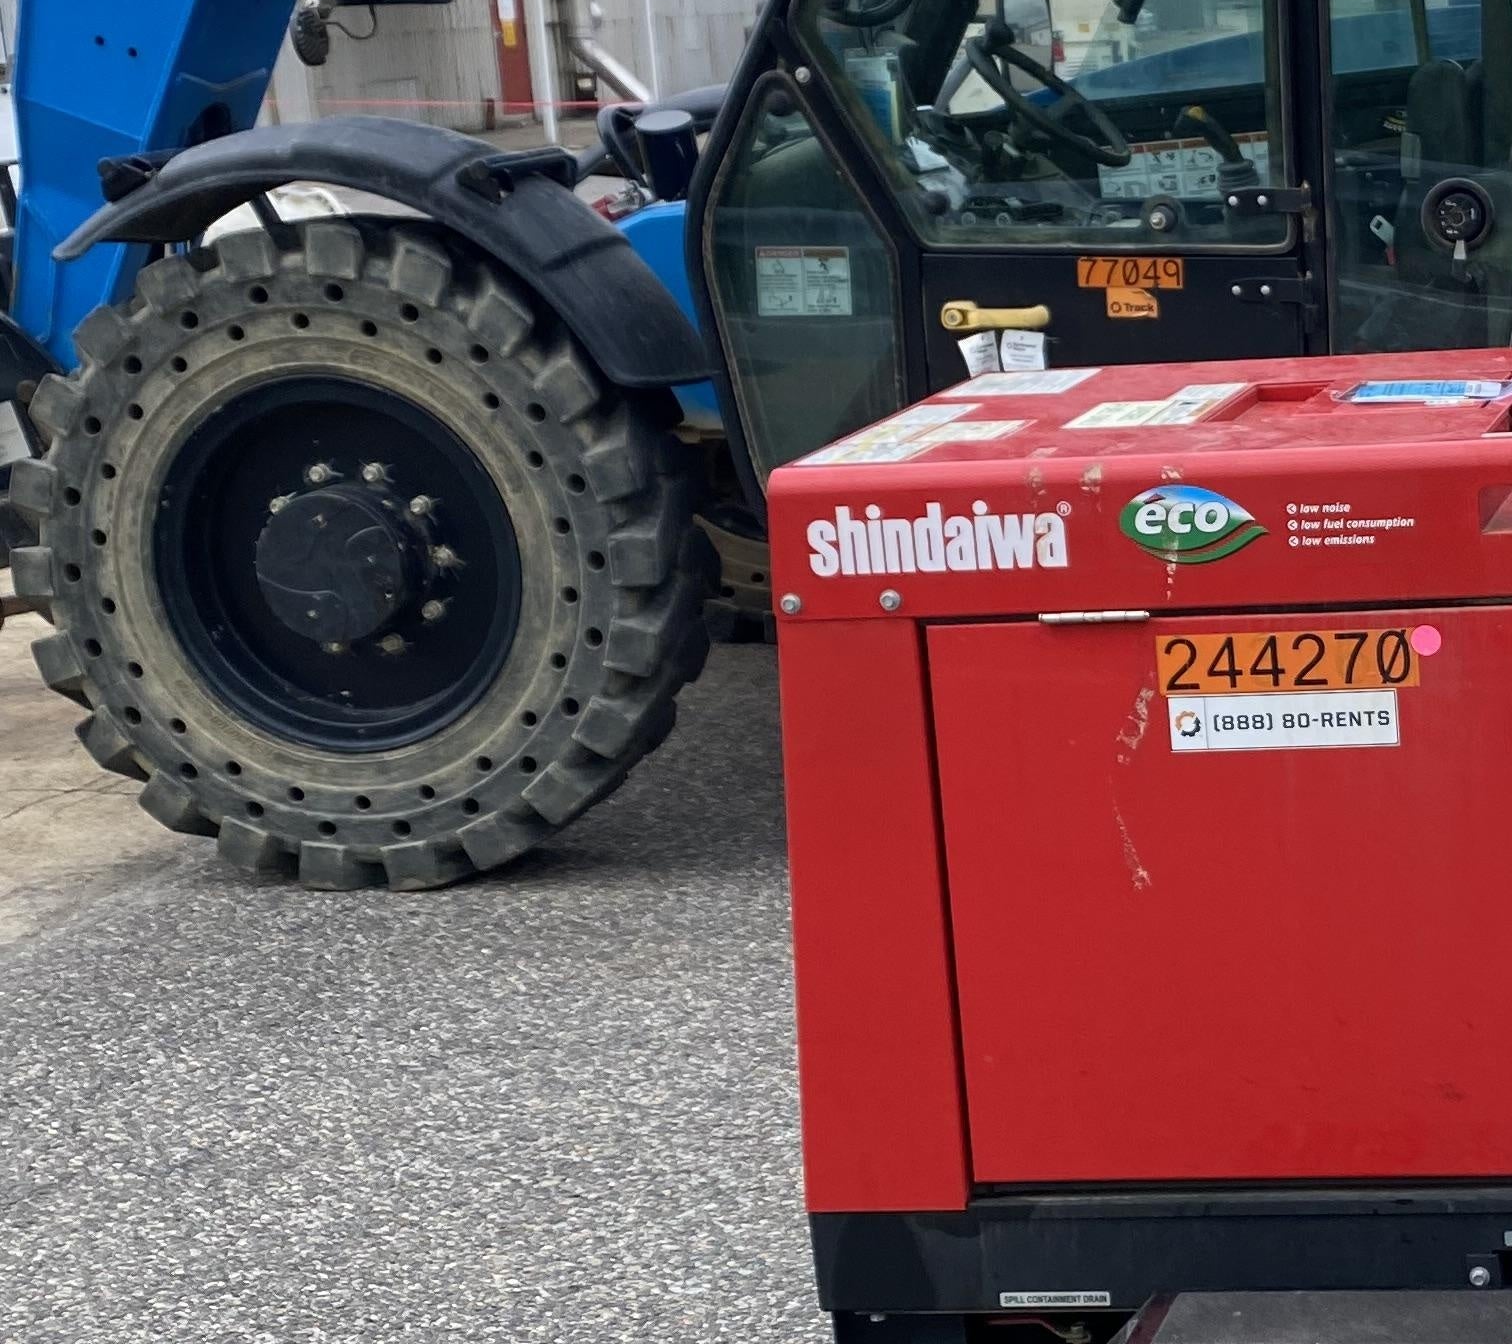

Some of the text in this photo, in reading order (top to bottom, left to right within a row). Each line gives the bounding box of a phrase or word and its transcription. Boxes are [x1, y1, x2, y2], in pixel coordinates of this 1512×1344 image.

[1080, 259, 1180, 286] 77049
[1124, 303, 1154, 312] Track
[1300, 502, 1351, 513] low noise
[1301, 517, 1414, 530] low fuel consumption
[1302, 535, 1375, 546] low emissions
[1164, 630, 1411, 691] 244270
[1213, 710, 1390, 731] (888) 80-RENTS
